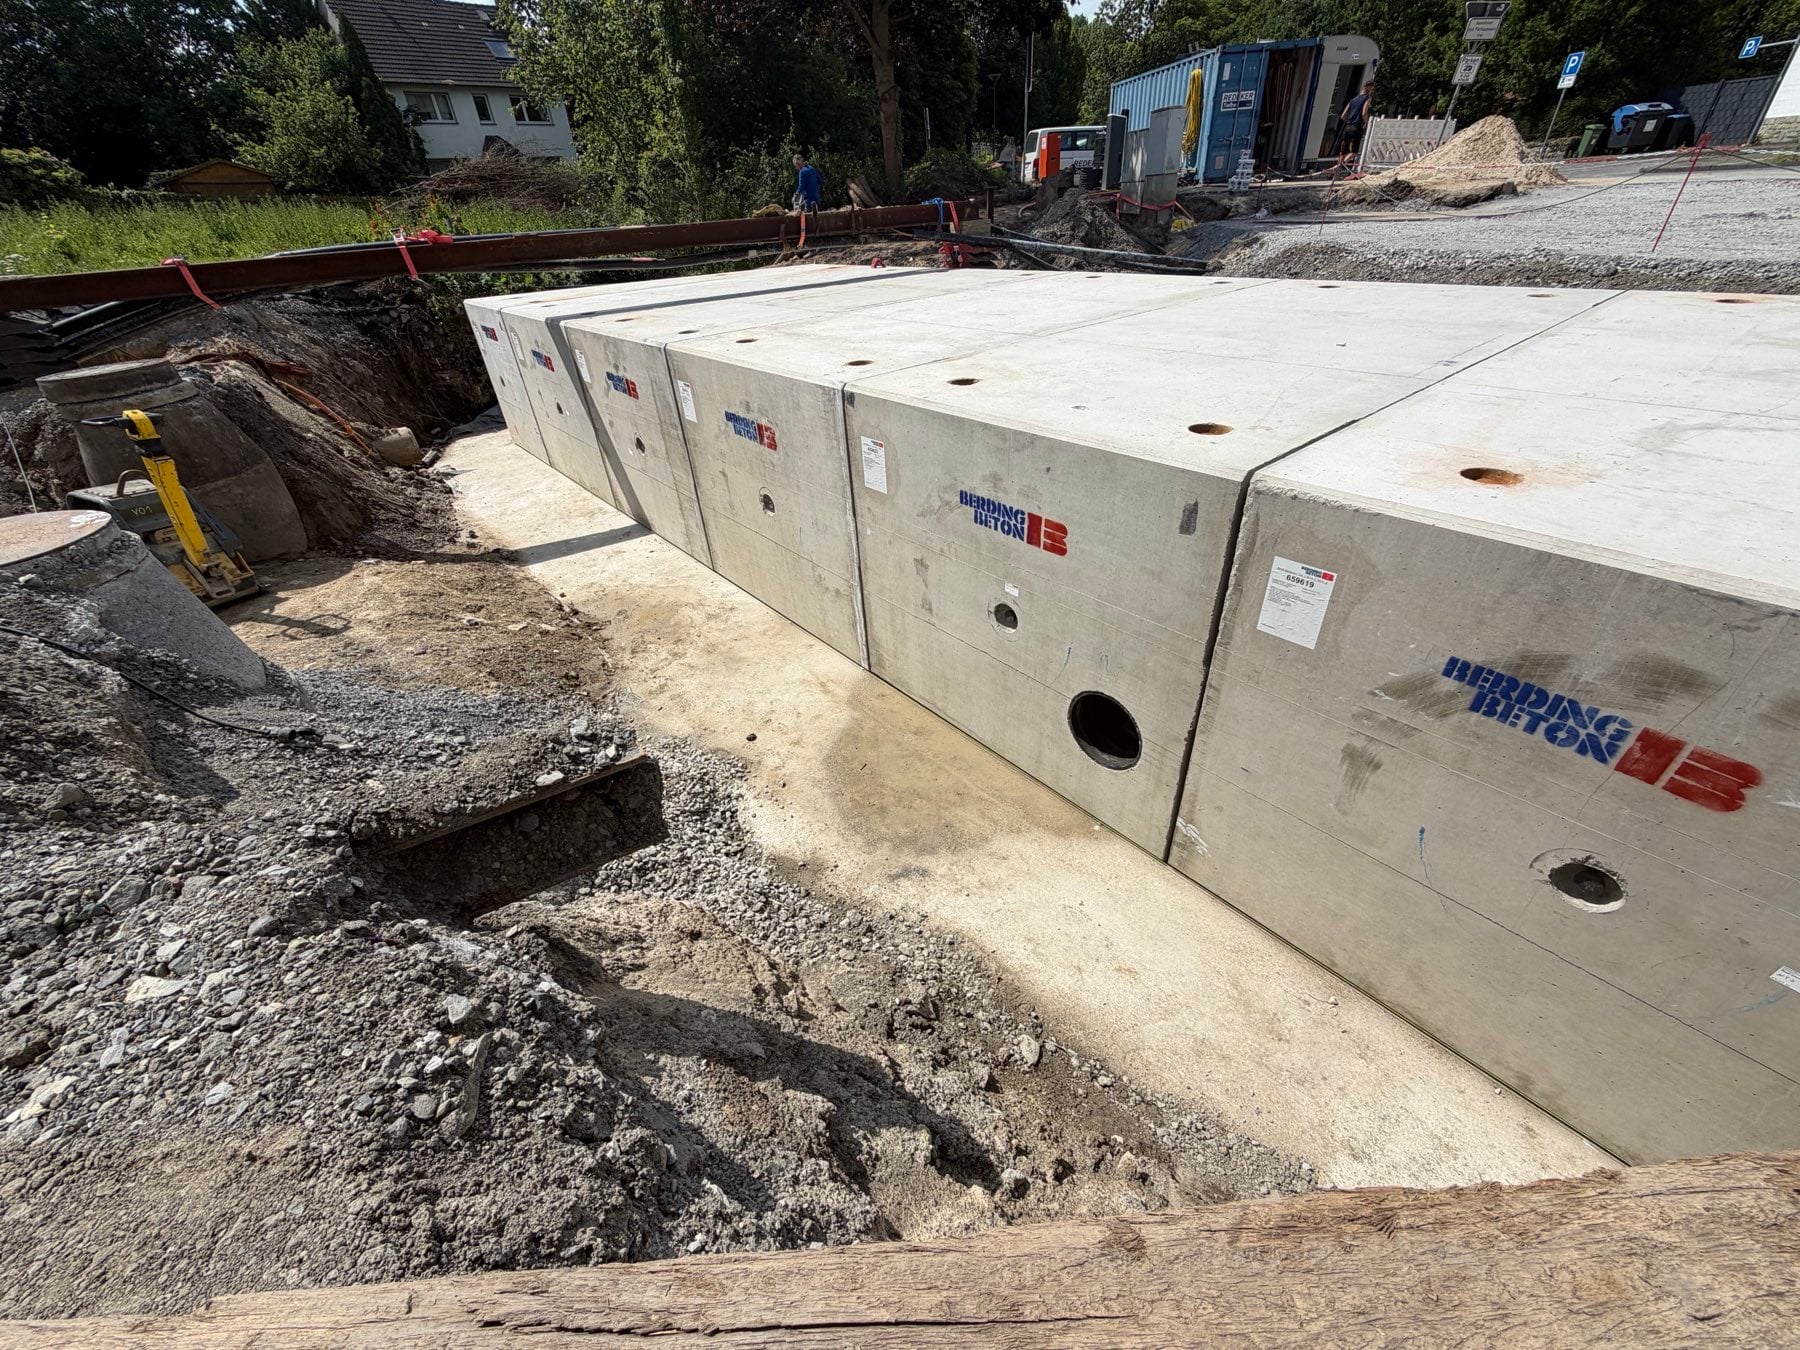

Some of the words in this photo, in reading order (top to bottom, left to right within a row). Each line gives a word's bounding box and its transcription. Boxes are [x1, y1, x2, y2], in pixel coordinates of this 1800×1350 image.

[1566, 56, 1579, 73] P
[1223, 92, 1254, 101] REDKER
[1074, 159, 1094, 167] REDE
[959, 489, 1026, 526] BERDING
[973, 509, 1025, 542] BETON
[1286, 574, 1315, 588] 659619
[1441, 655, 1634, 737] BERDING
[1468, 690, 1621, 765] BETON
